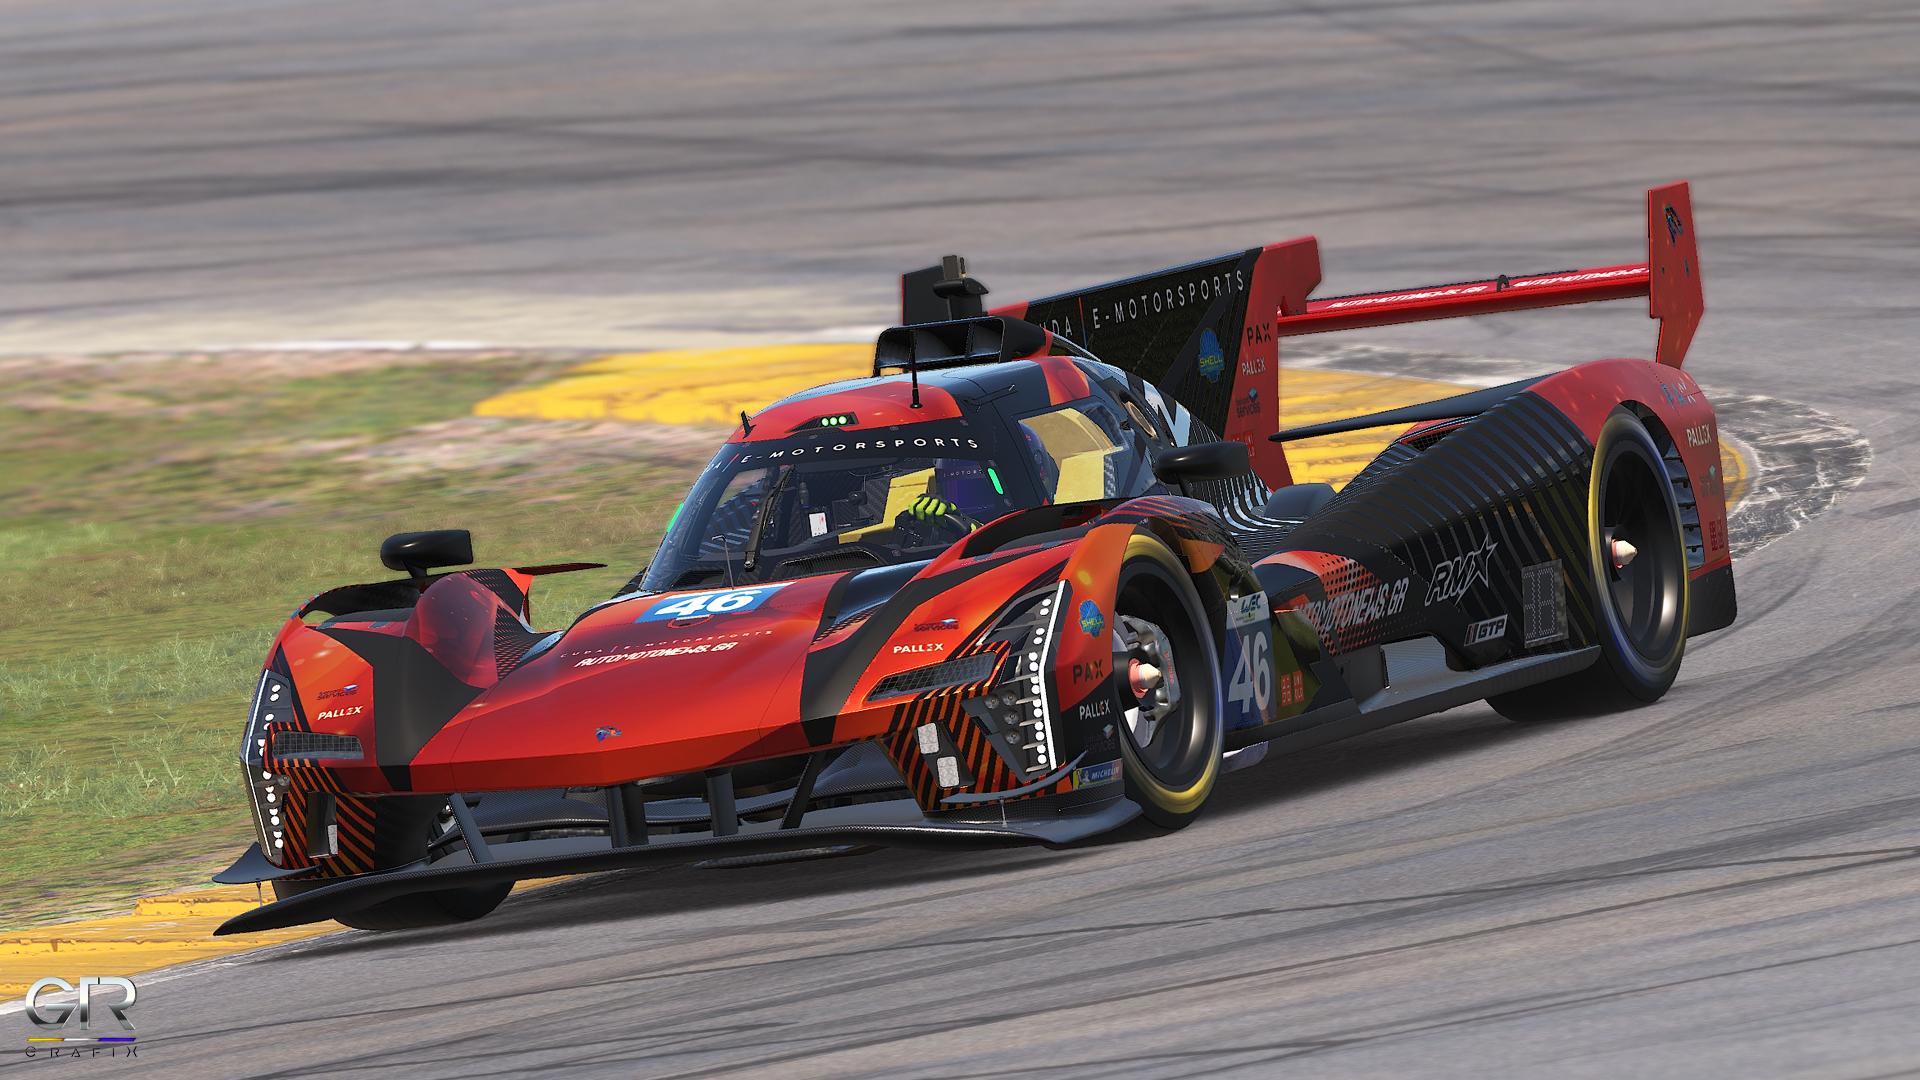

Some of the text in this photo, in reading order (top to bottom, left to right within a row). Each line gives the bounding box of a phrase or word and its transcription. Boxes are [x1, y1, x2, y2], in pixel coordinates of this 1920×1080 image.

[1093, 270, 1244, 329] E-MOTORSPORTS
[1247, 322, 1271, 346] PAX
[1242, 357, 1266, 376] PALLEX
[1686, 424, 1712, 447] PALLEX
[740, 438, 978, 464] E-MOTORSPORTS
[654, 589, 762, 616] 46
[1478, 620, 1504, 638] GTP
[560, 648, 603, 658] CUDA
[893, 643, 944, 654] PALLEX
[1073, 659, 1103, 687] PAX
[1227, 631, 1271, 714] 46
[317, 705, 364, 720] PALLEX
[1080, 698, 1110, 720] PALLEX
[1091, 766, 1119, 780] MICHELIN
